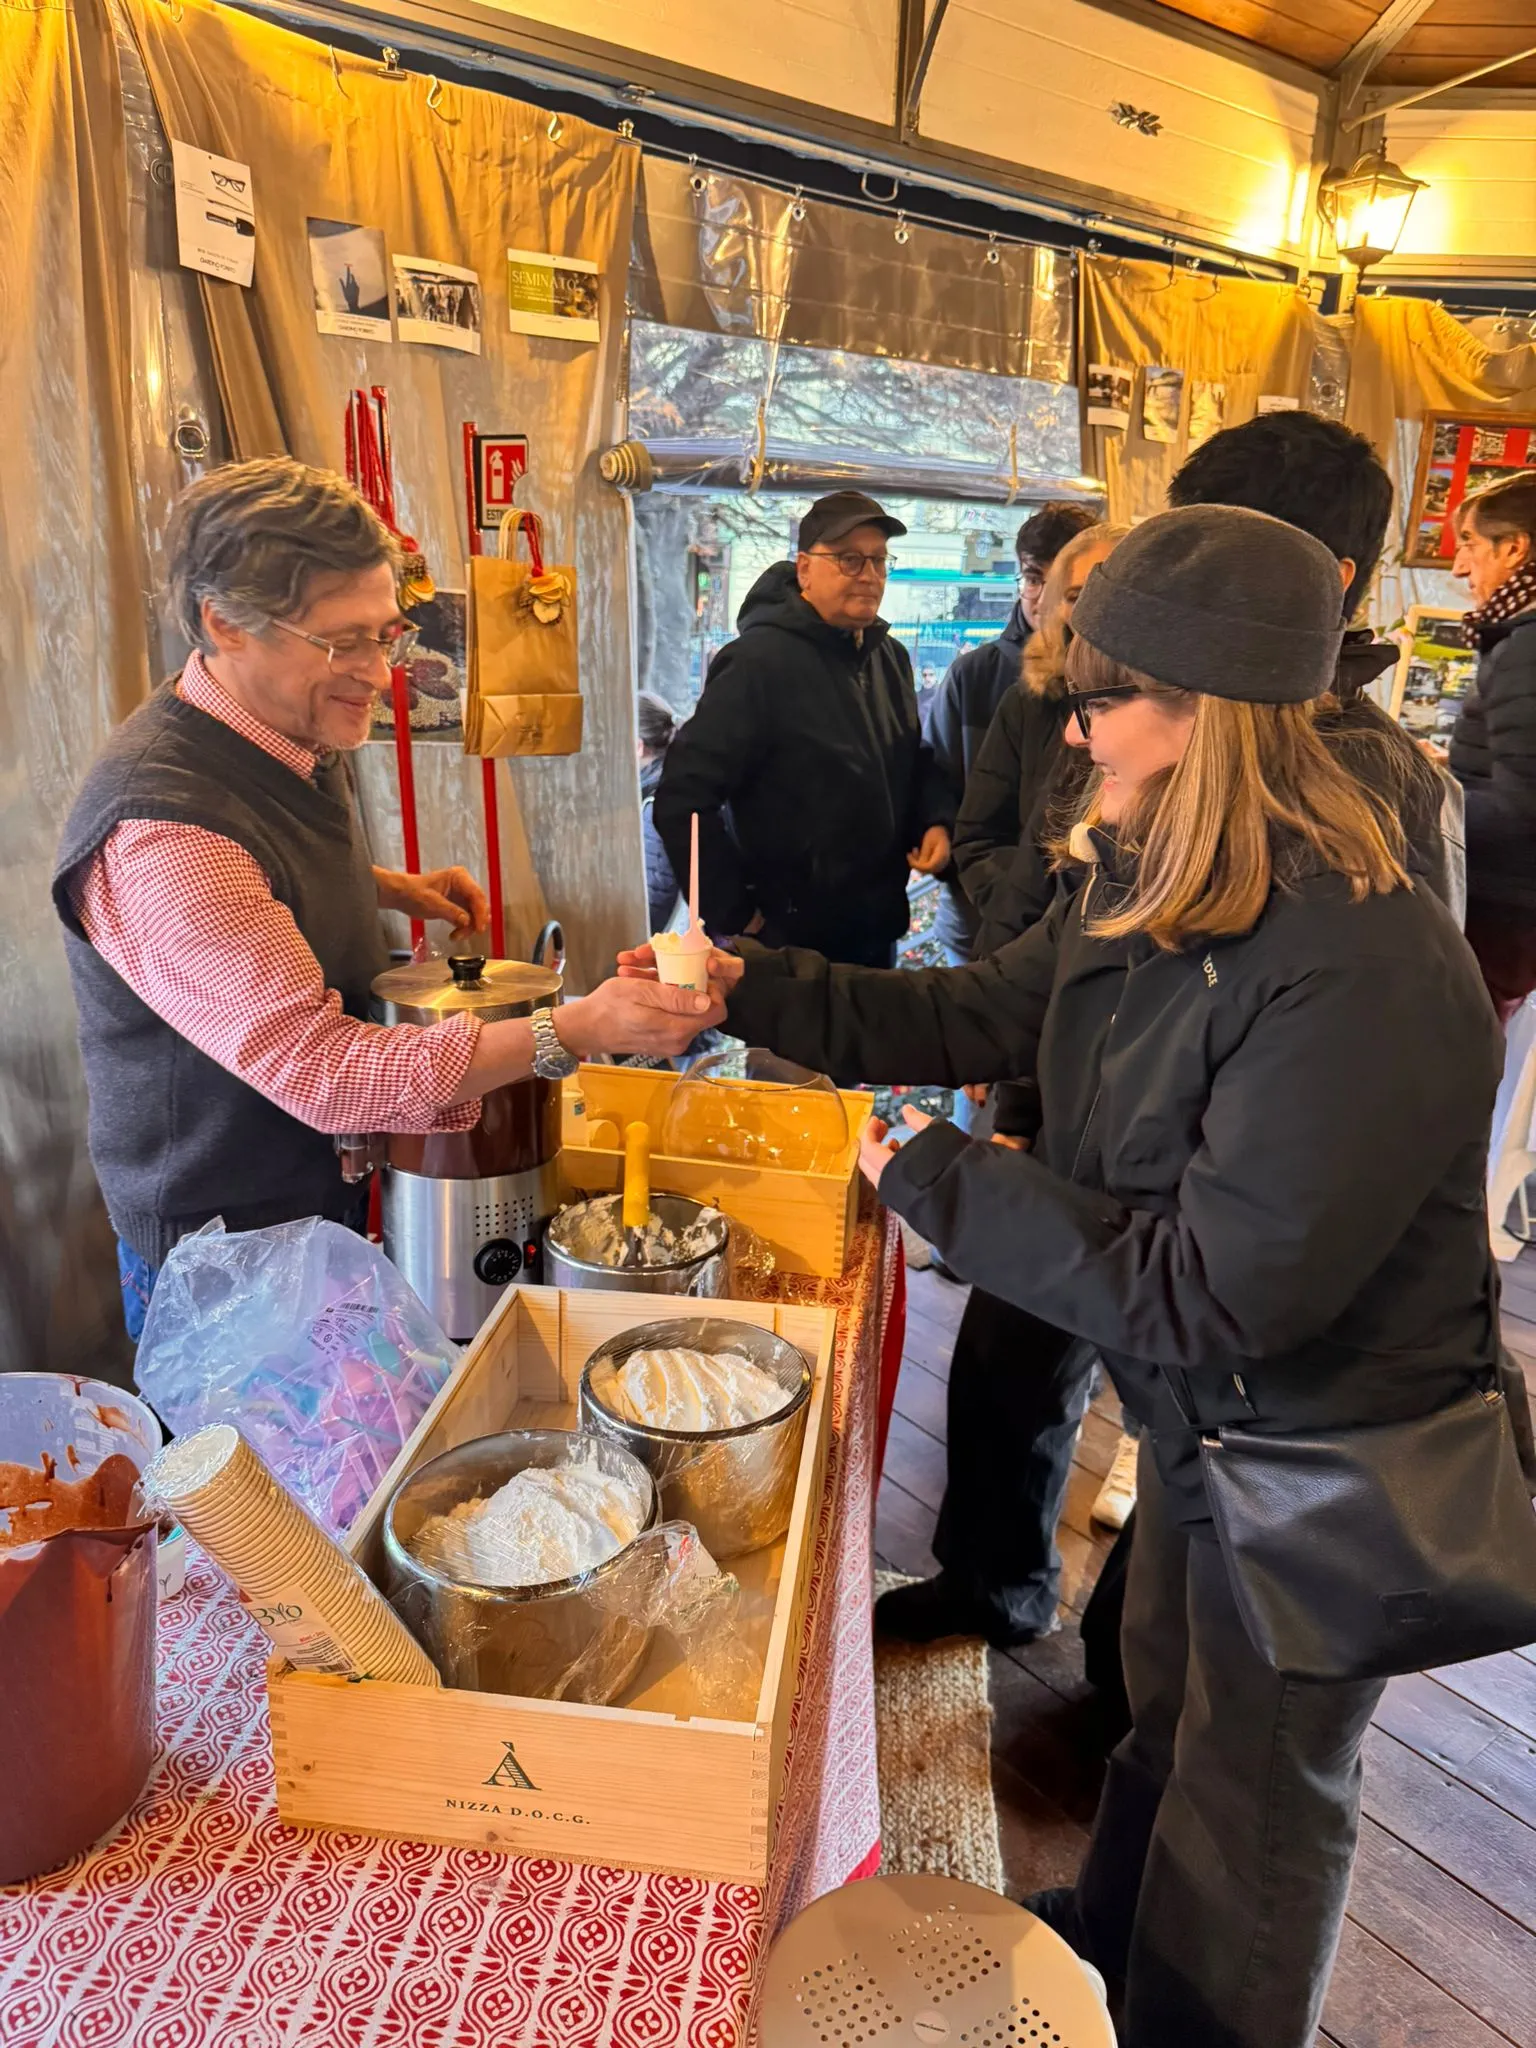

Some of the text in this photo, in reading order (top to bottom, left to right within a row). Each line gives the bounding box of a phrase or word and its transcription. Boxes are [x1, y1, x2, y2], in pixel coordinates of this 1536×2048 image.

[511, 270, 577, 291] SEMINATO
[486, 509, 508, 521] ESTI
[446, 1799, 591, 1825] NIZZA D.O.C.G.
